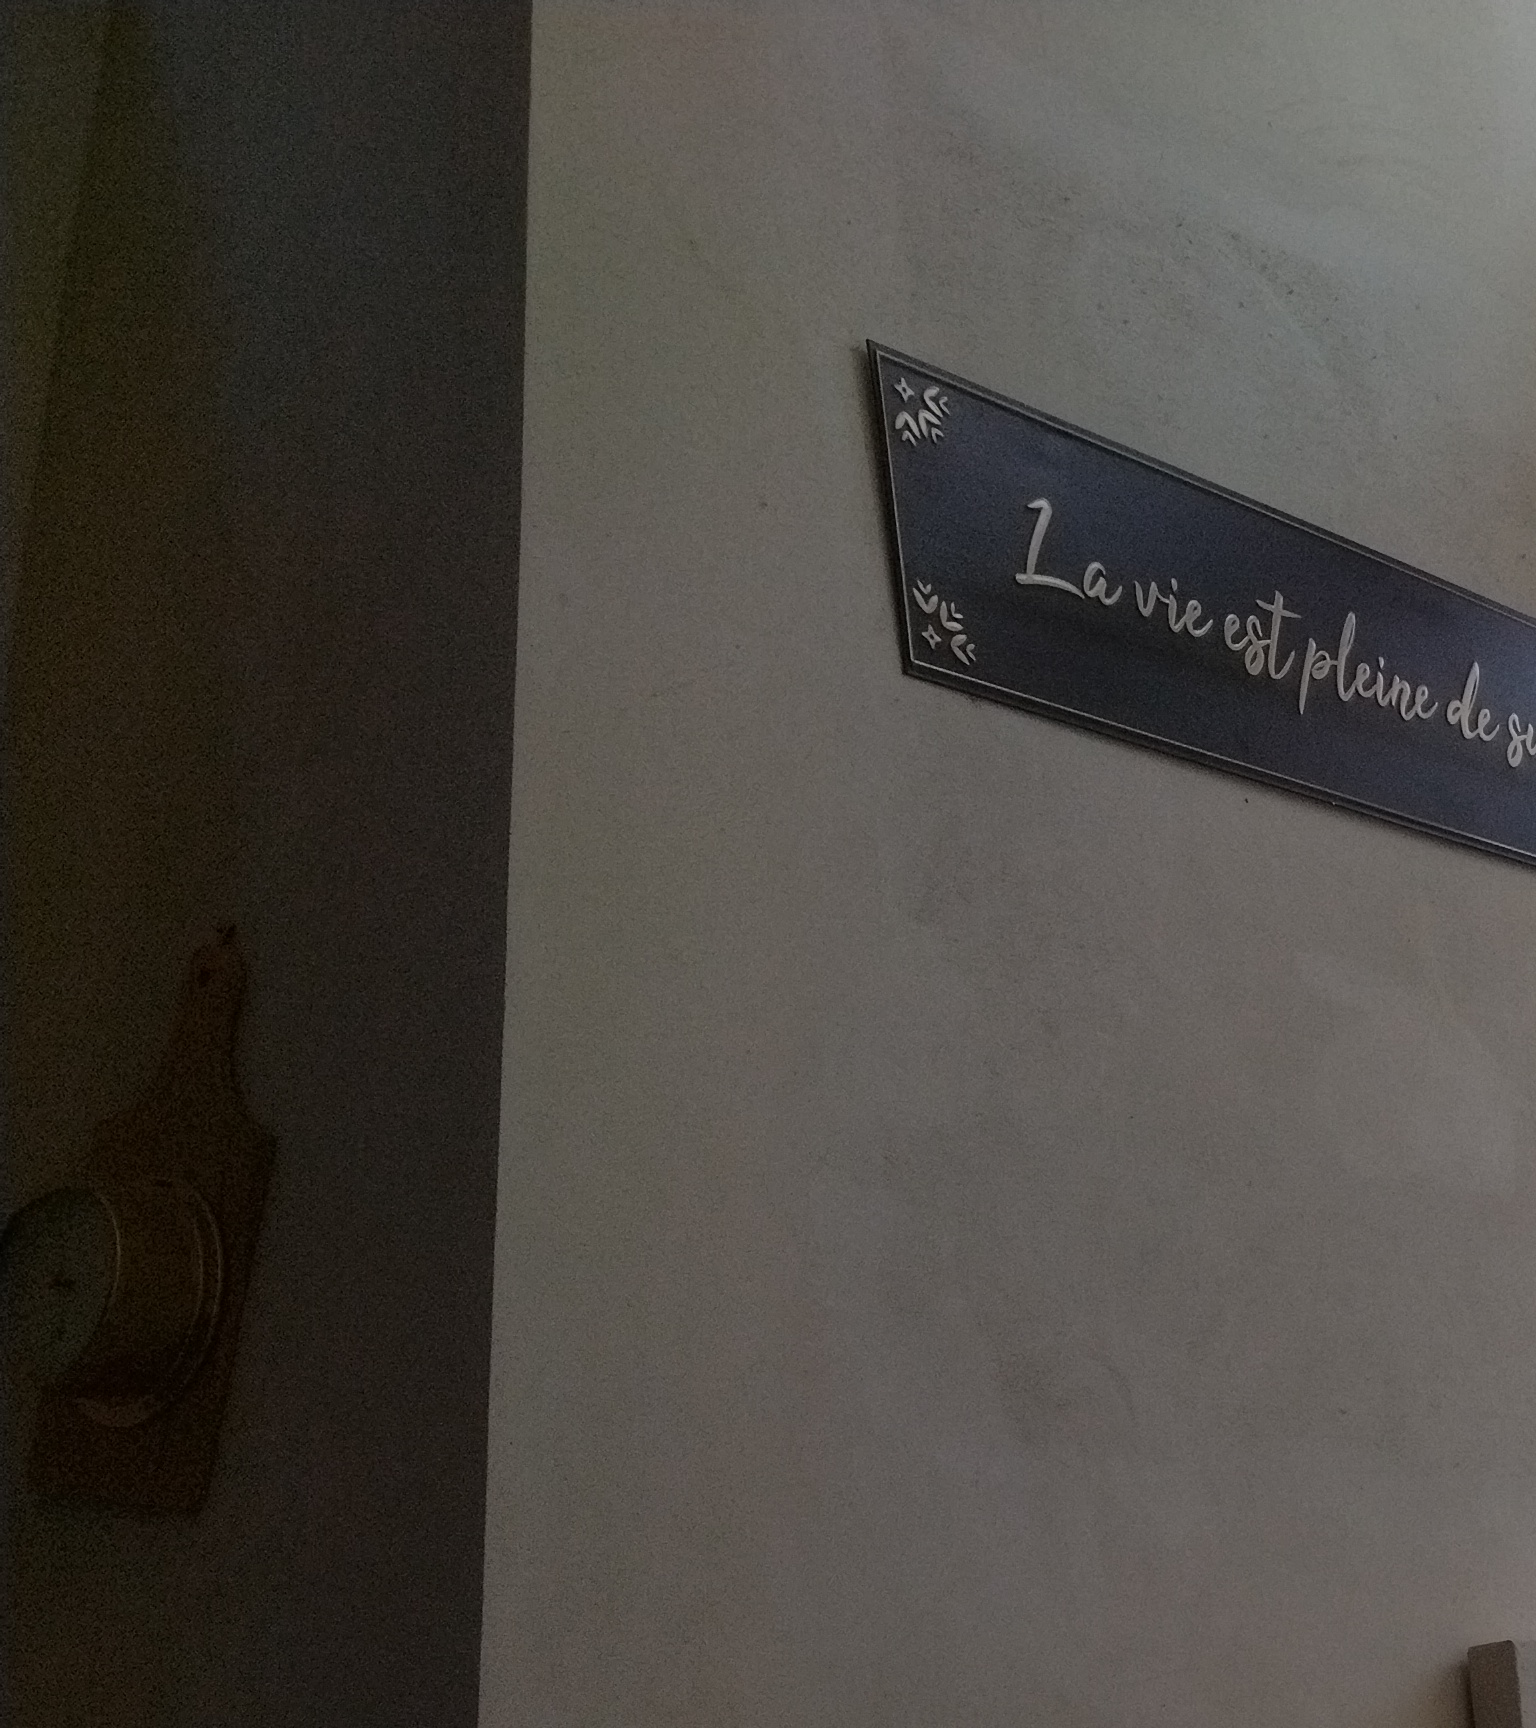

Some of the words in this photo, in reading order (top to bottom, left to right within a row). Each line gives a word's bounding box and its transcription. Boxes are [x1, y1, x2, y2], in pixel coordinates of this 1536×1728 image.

[1015, 497, 1122, 605] La
[1135, 574, 1212, 638] vie
[1224, 591, 1301, 681] est
[1299, 612, 1438, 715] pleine
[1447, 661, 1500, 742] de
